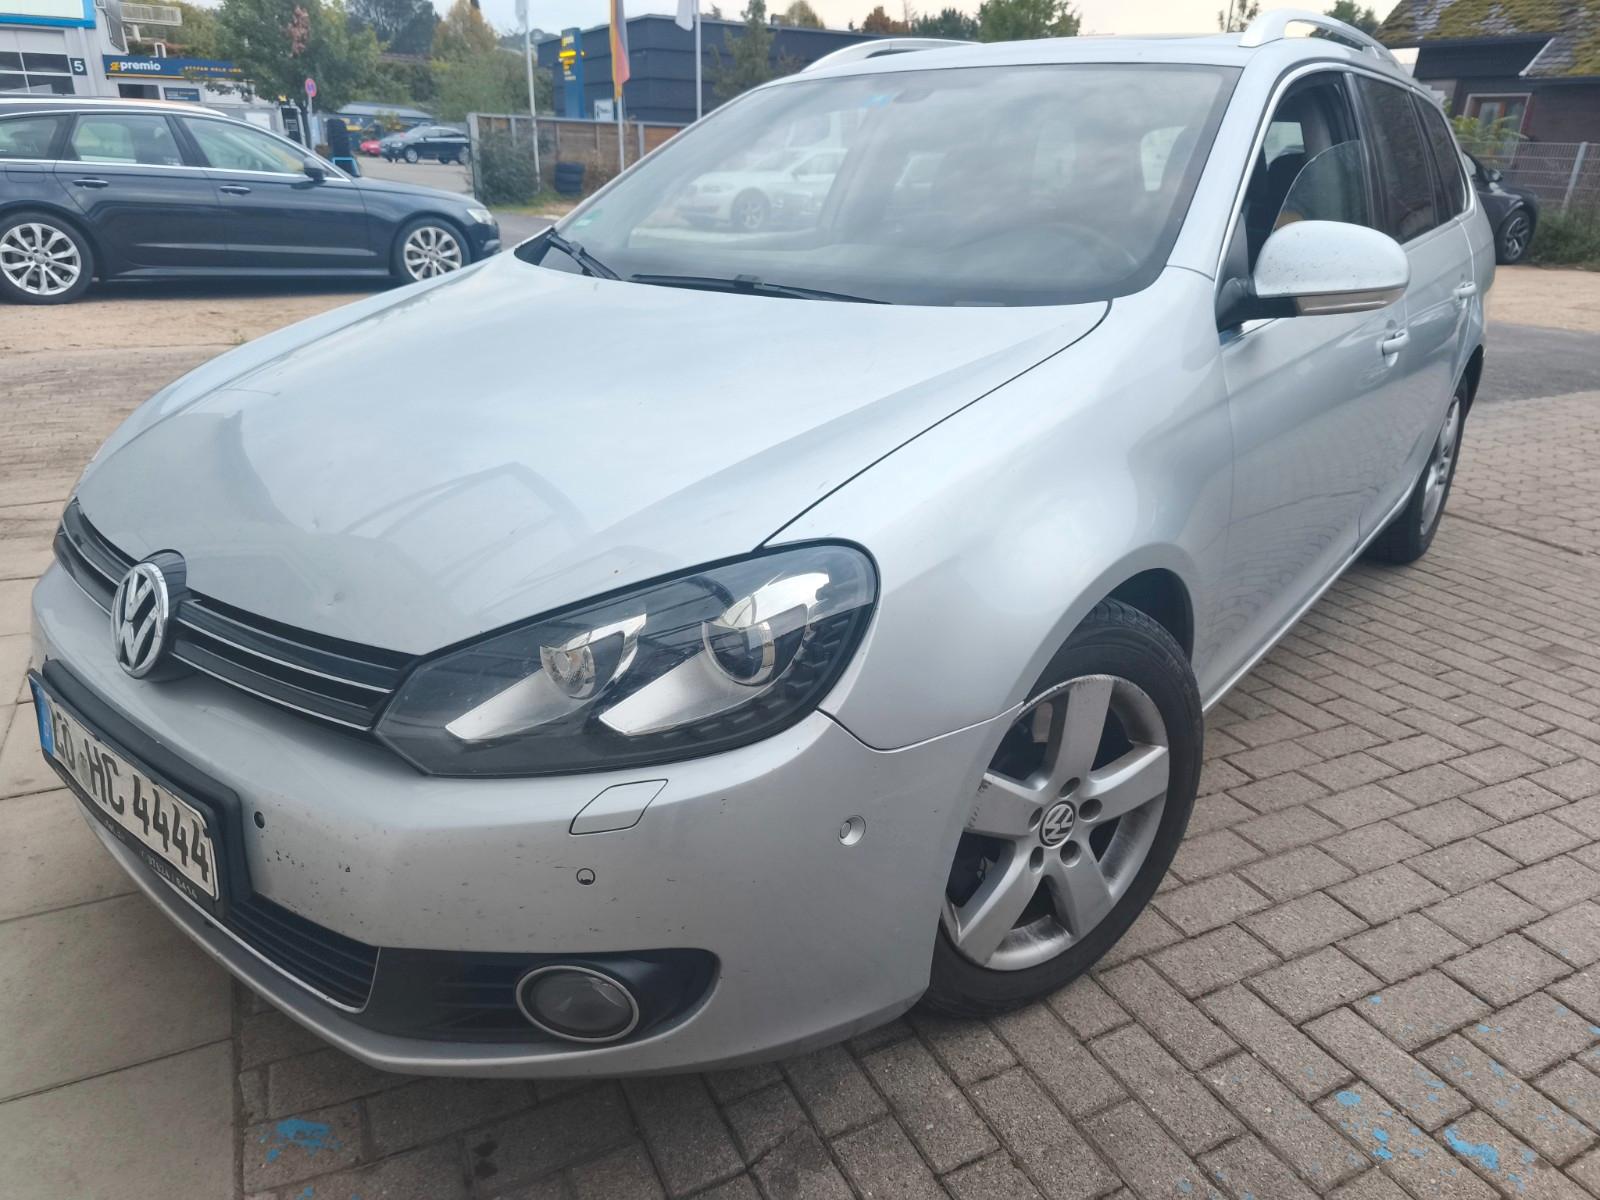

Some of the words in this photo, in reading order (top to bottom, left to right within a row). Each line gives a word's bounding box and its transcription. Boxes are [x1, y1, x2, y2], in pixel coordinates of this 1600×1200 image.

[73, 60, 84, 73] 5
[119, 60, 161, 72] premio
[84, 738, 125, 816] HC
[132, 773, 209, 884] 4444
